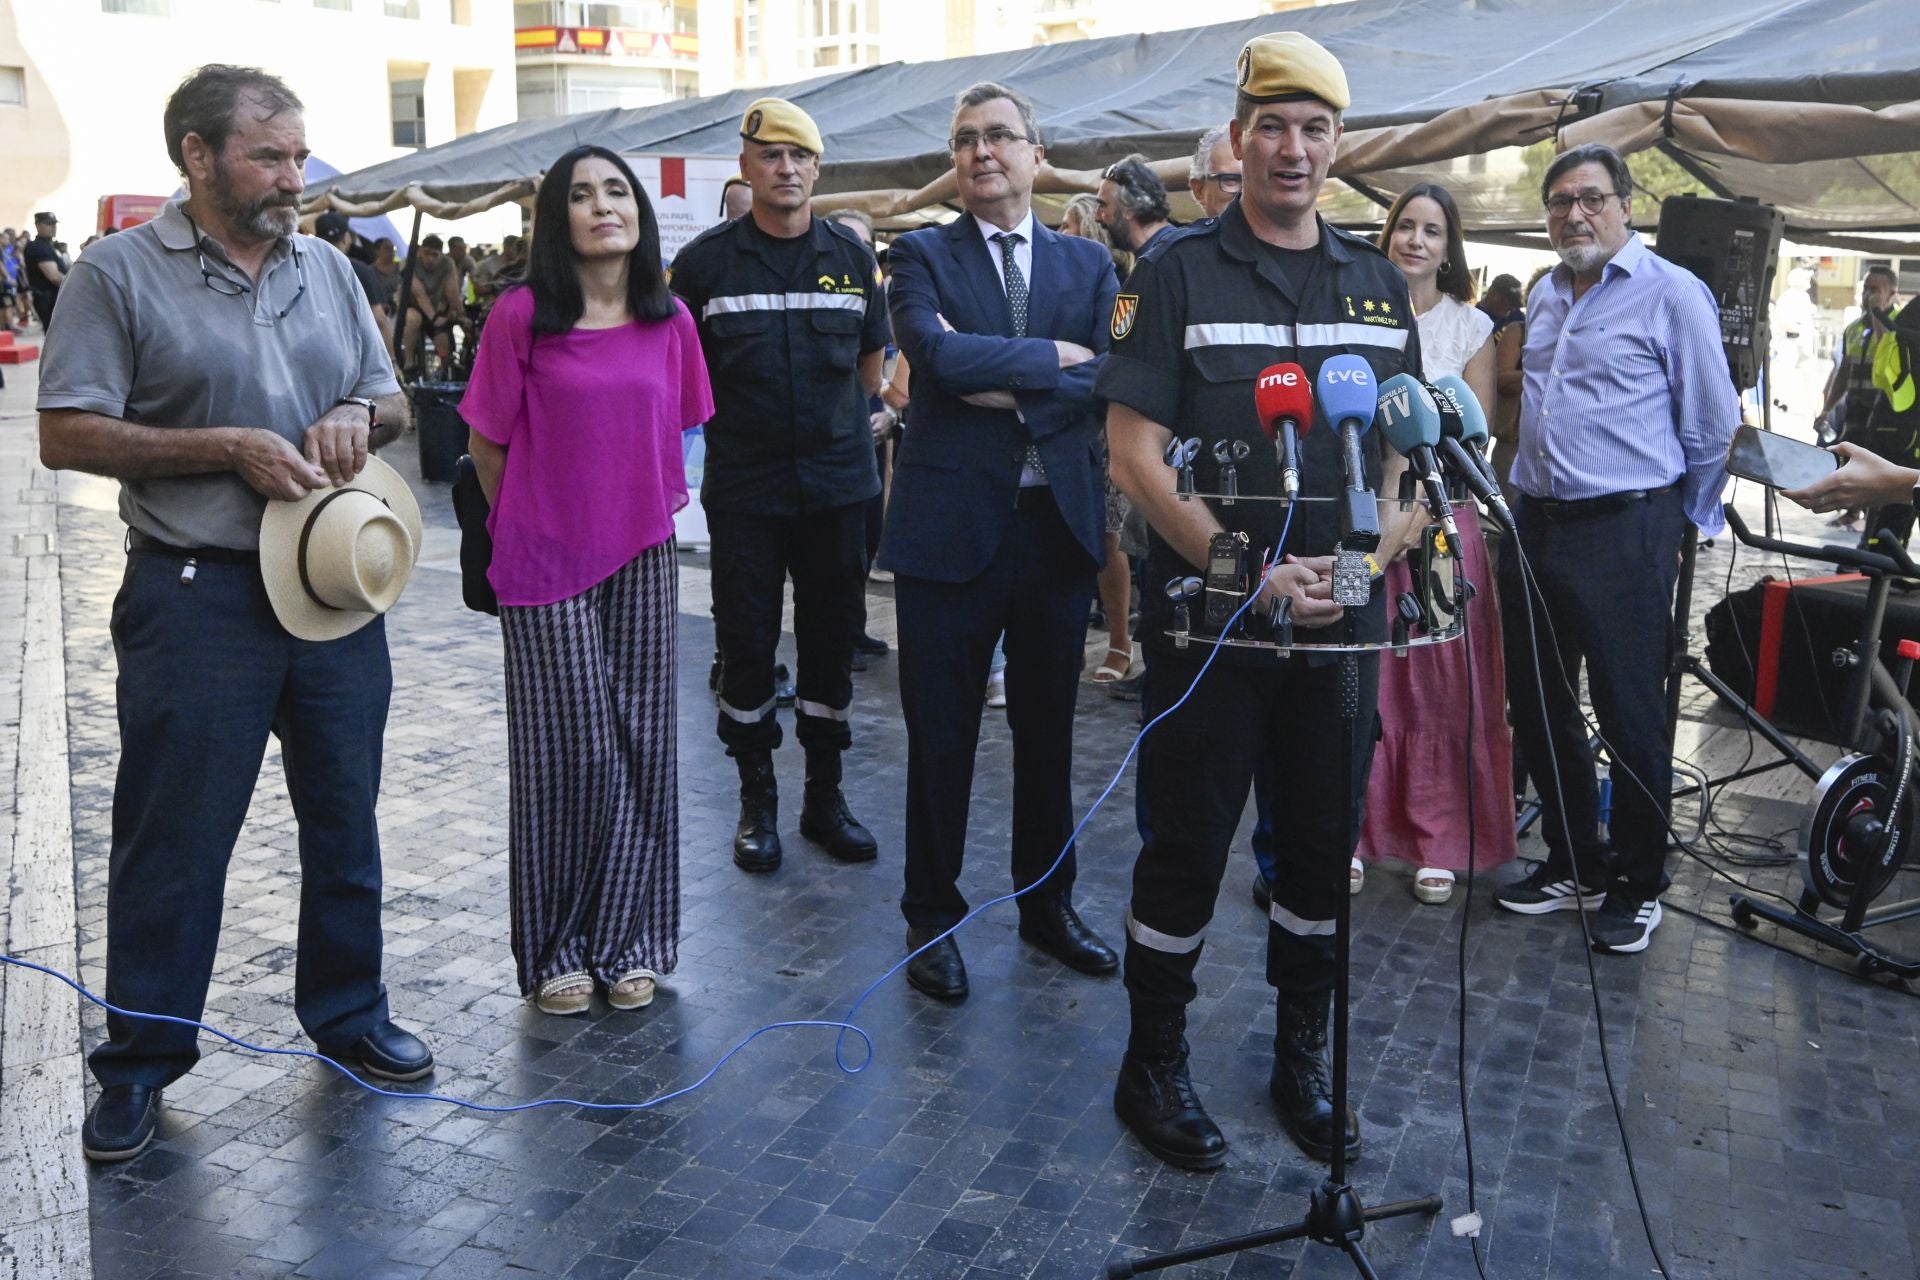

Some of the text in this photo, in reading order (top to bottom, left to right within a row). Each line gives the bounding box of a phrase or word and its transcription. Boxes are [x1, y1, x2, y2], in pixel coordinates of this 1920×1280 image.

[659, 223, 709, 232] MPORTANTE
[1260, 371, 1298, 389] rne
[1326, 369, 1368, 386] tve
[1377, 385, 1408, 404] POPULAR
[1379, 391, 1411, 426] TV
